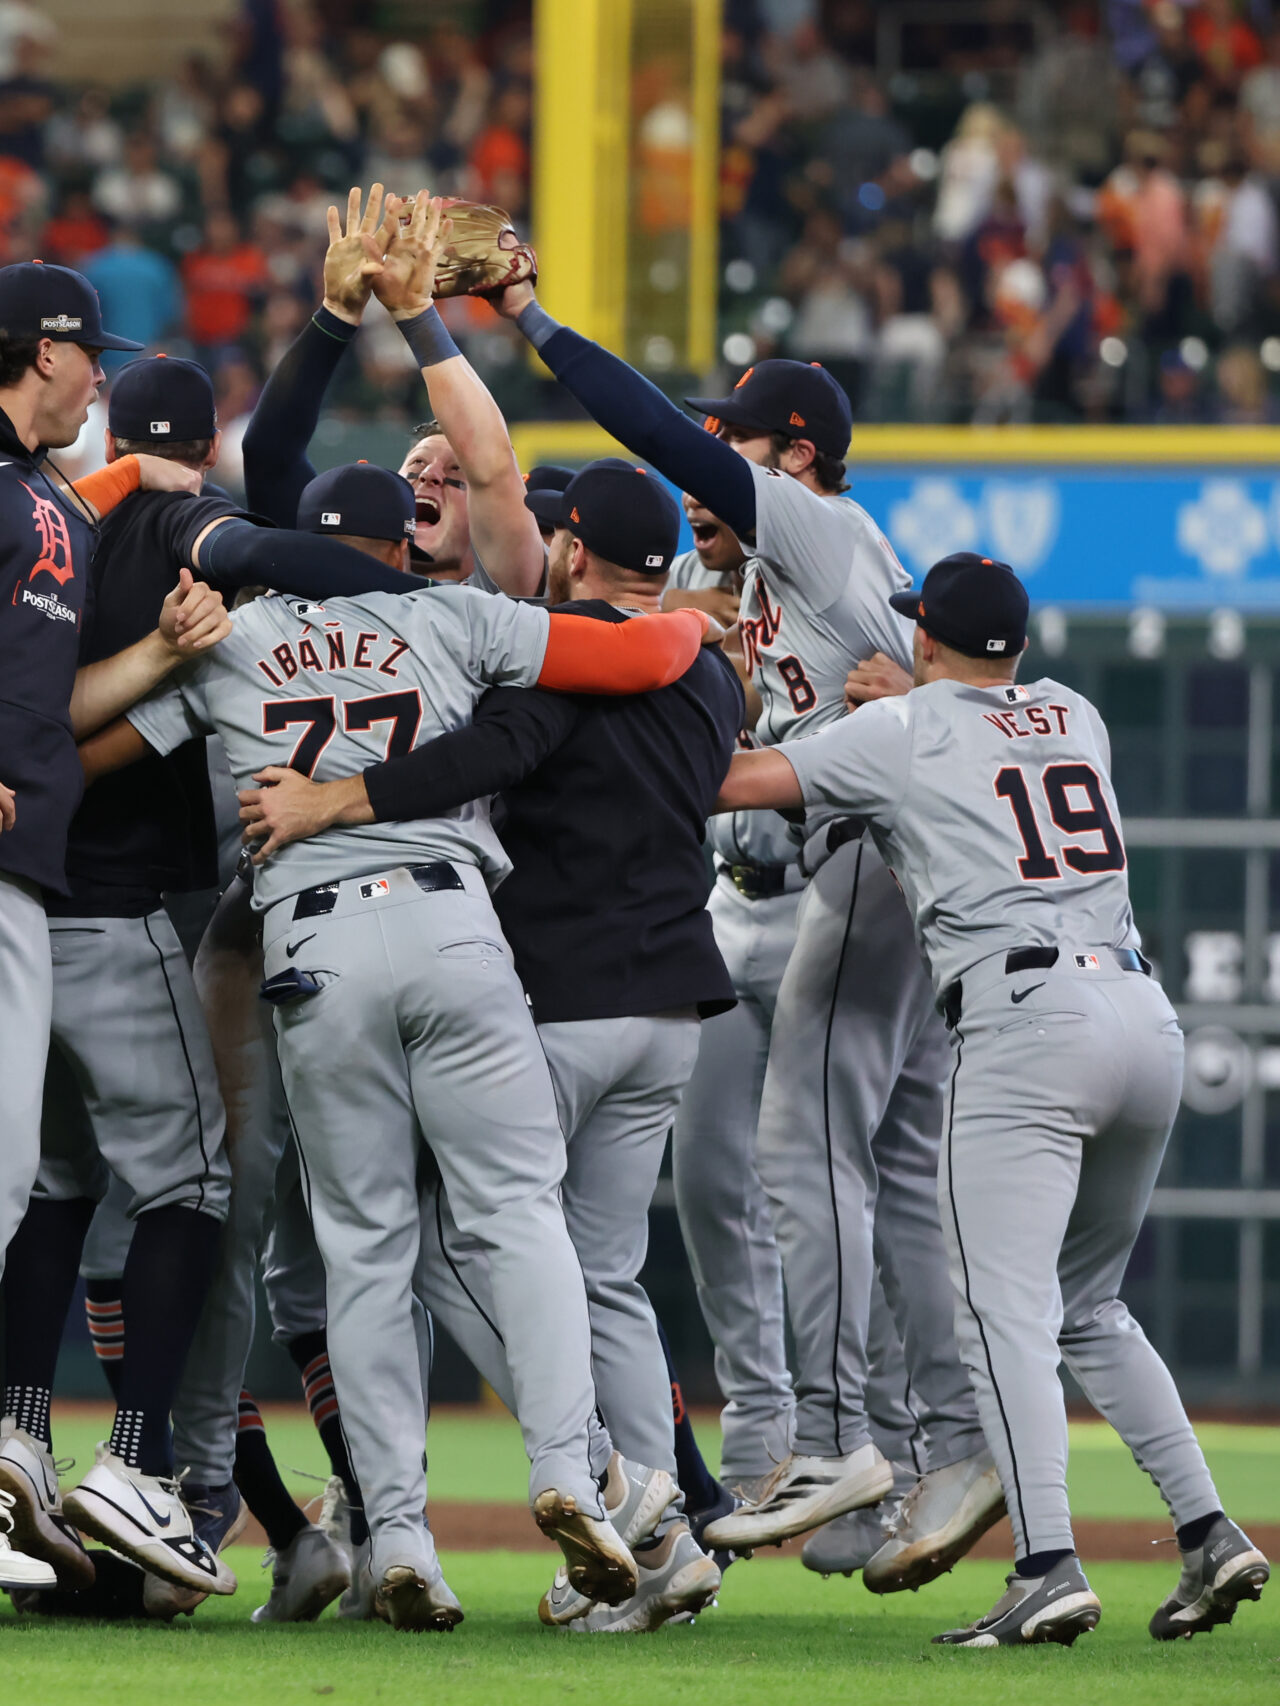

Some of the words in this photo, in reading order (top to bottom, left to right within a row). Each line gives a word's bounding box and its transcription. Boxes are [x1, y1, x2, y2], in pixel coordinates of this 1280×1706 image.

[42, 319, 81, 329] POSTSEASON
[22, 589, 77, 624] POSTSEASON
[256, 621, 411, 688] IBÁÑEZ
[775, 653, 818, 716] 8
[261, 686, 424, 780] 77
[980, 703, 1071, 740] VEST
[991, 760, 1130, 881] 19
